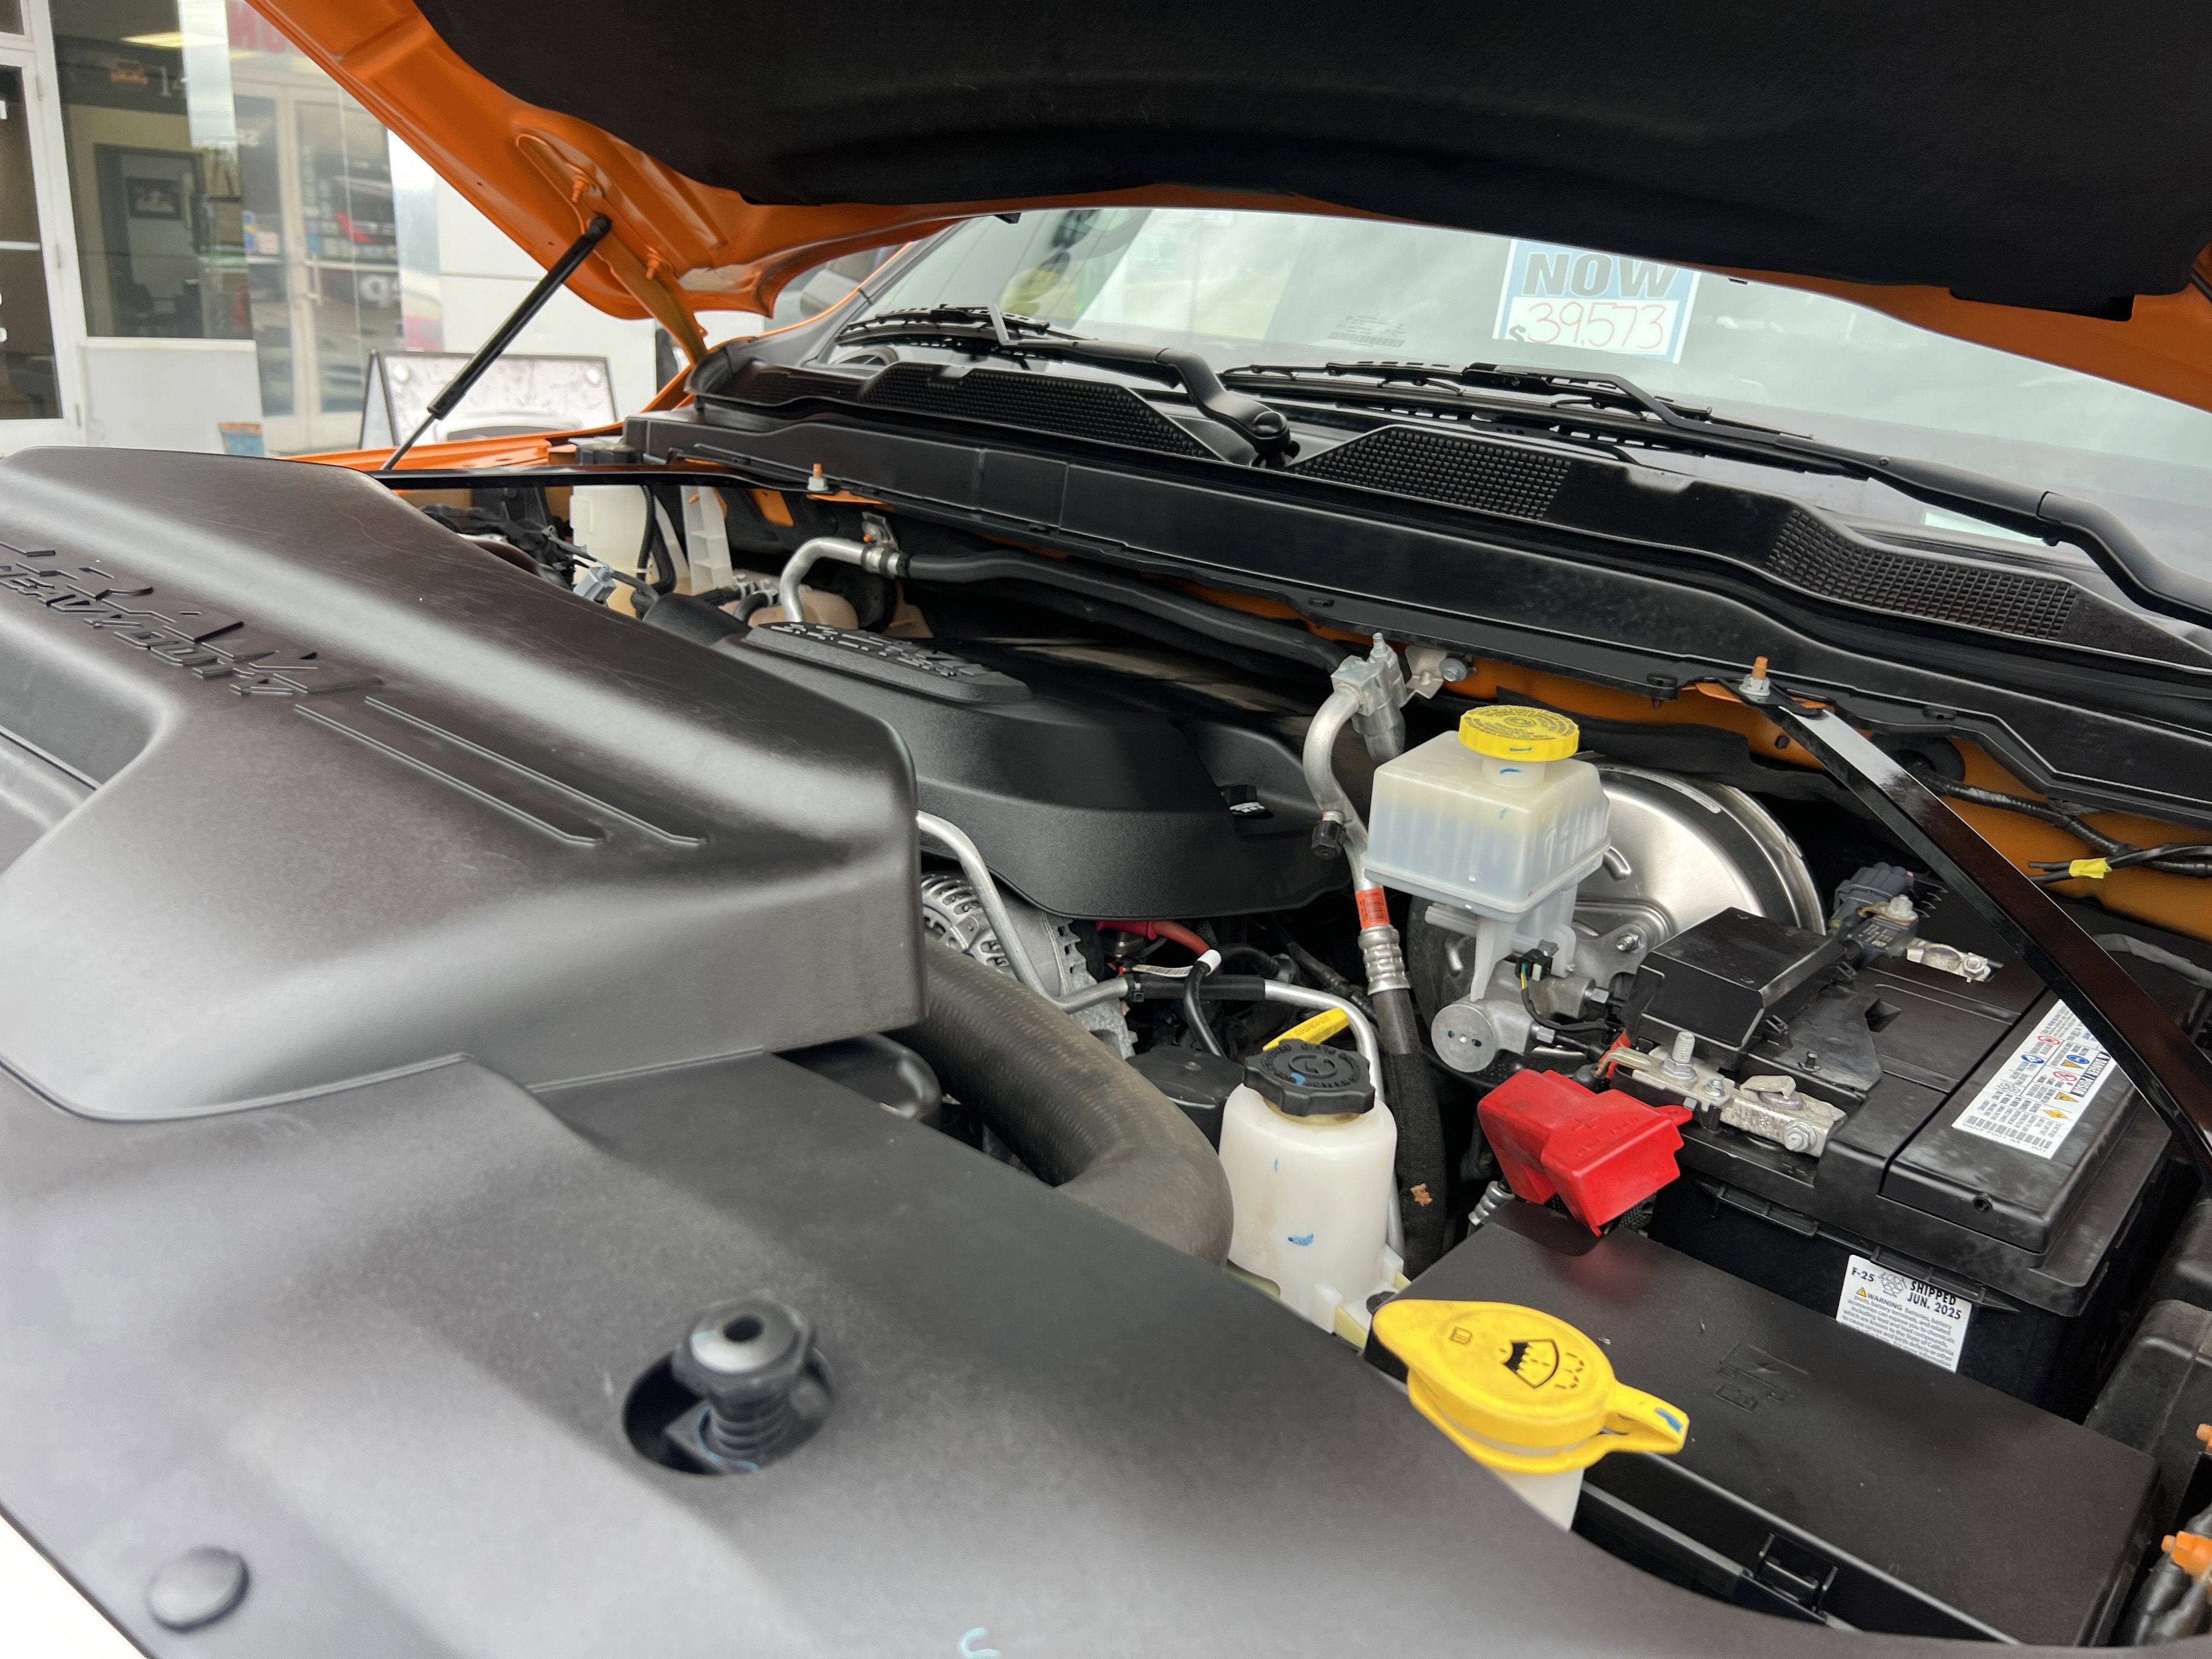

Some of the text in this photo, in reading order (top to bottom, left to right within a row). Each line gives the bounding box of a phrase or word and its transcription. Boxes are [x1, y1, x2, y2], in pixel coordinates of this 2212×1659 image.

[1521, 252, 1679, 299] NOW
[1850, 1266, 1875, 1283] F-25
[1867, 1293, 1903, 1310] WARNING
[1907, 1291, 1962, 1321] JUN. 2025
[1910, 1280, 1956, 1306] SHIPPED
